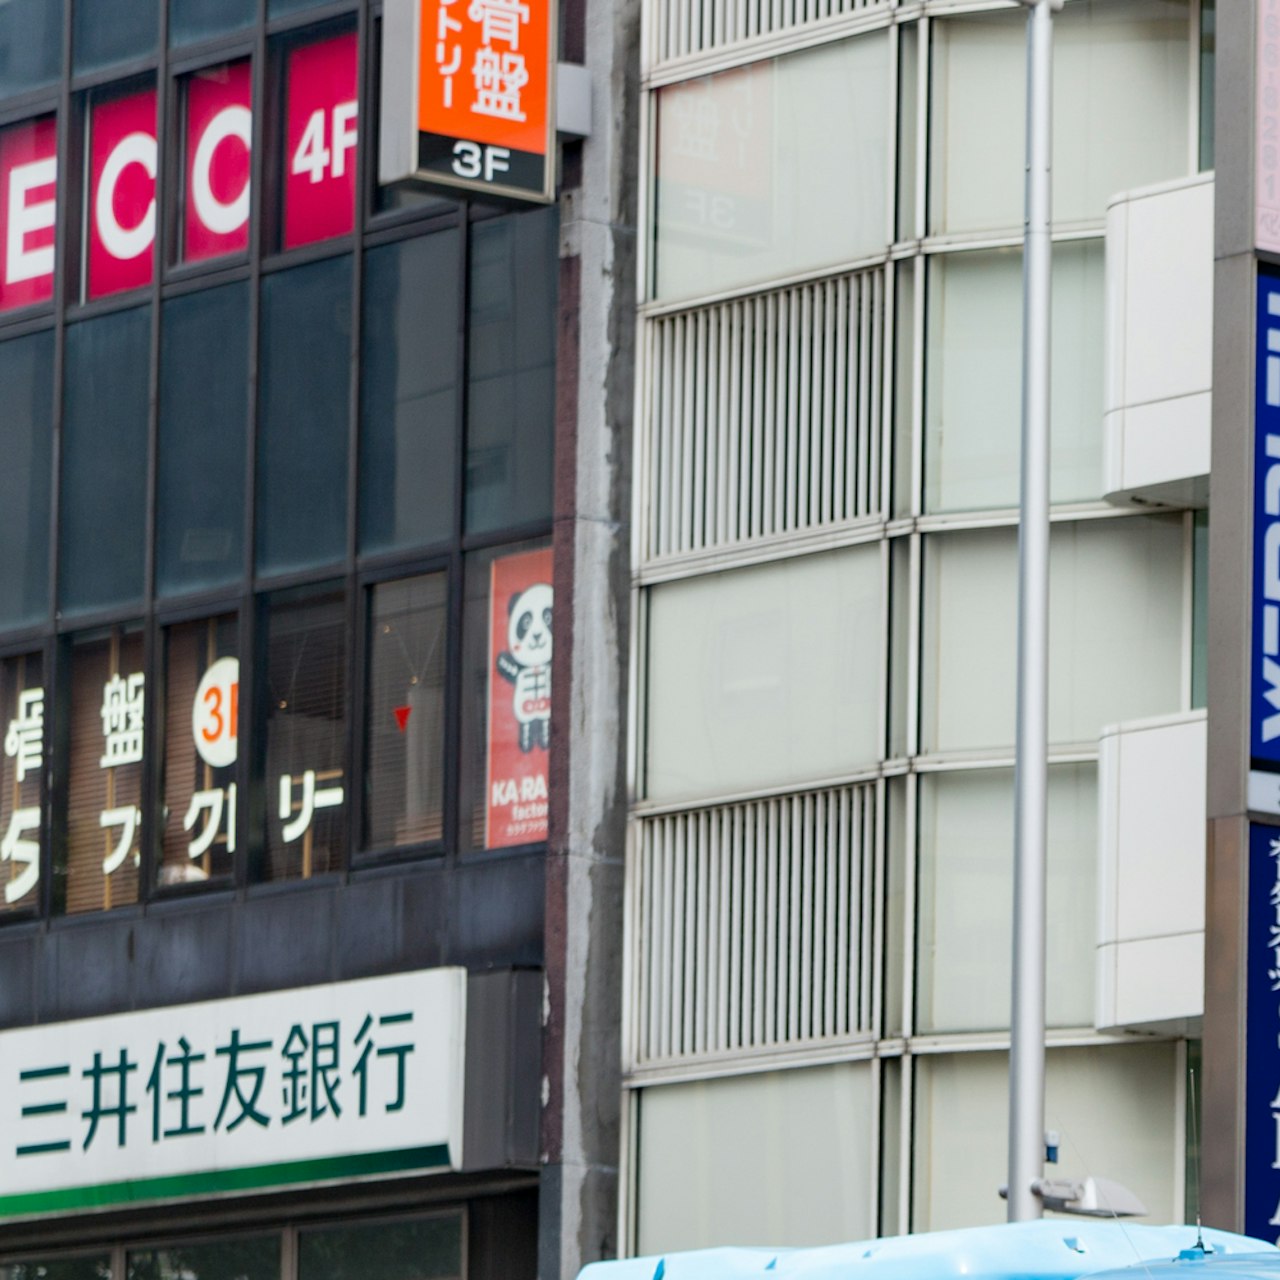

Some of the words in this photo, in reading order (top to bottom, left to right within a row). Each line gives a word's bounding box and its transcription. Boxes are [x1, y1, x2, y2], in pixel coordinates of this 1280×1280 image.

[436, 0, 463, 109] トリー
[292, 100, 359, 184] 4F
[452, 140, 511, 182] 3F
[15, 1010, 416, 1158] 三井住友銀行
